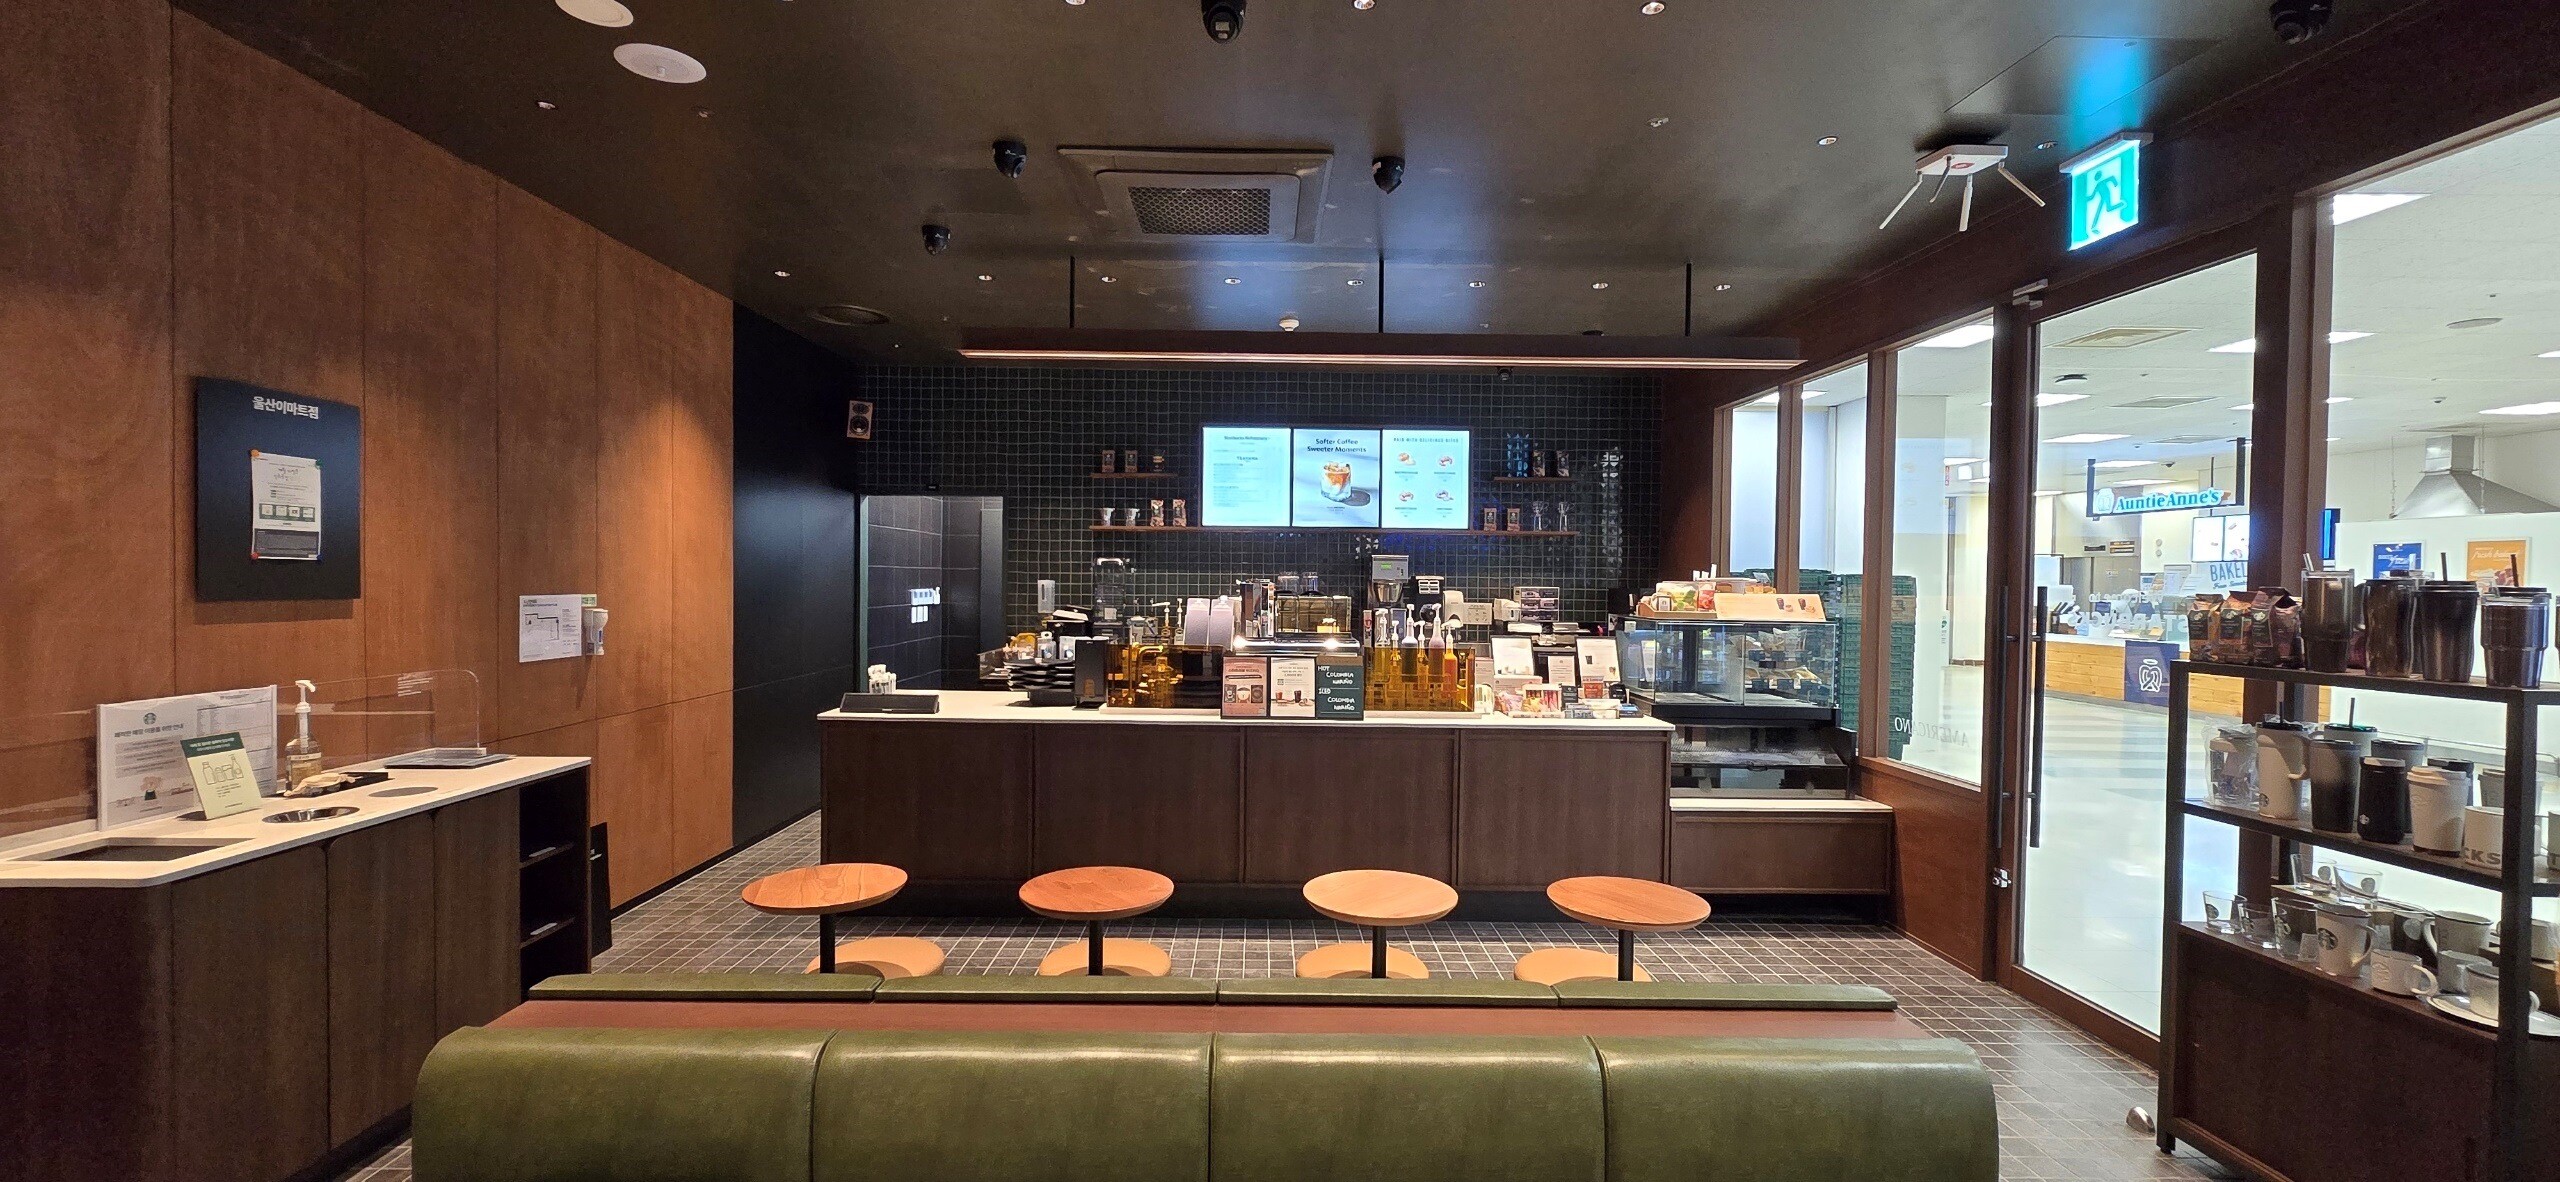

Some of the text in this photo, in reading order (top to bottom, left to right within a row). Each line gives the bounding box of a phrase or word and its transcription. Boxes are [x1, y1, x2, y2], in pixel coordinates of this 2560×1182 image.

[252, 396, 319, 420] 울산이마트점
[2116, 490, 2219, 511] Auntie Anne's
